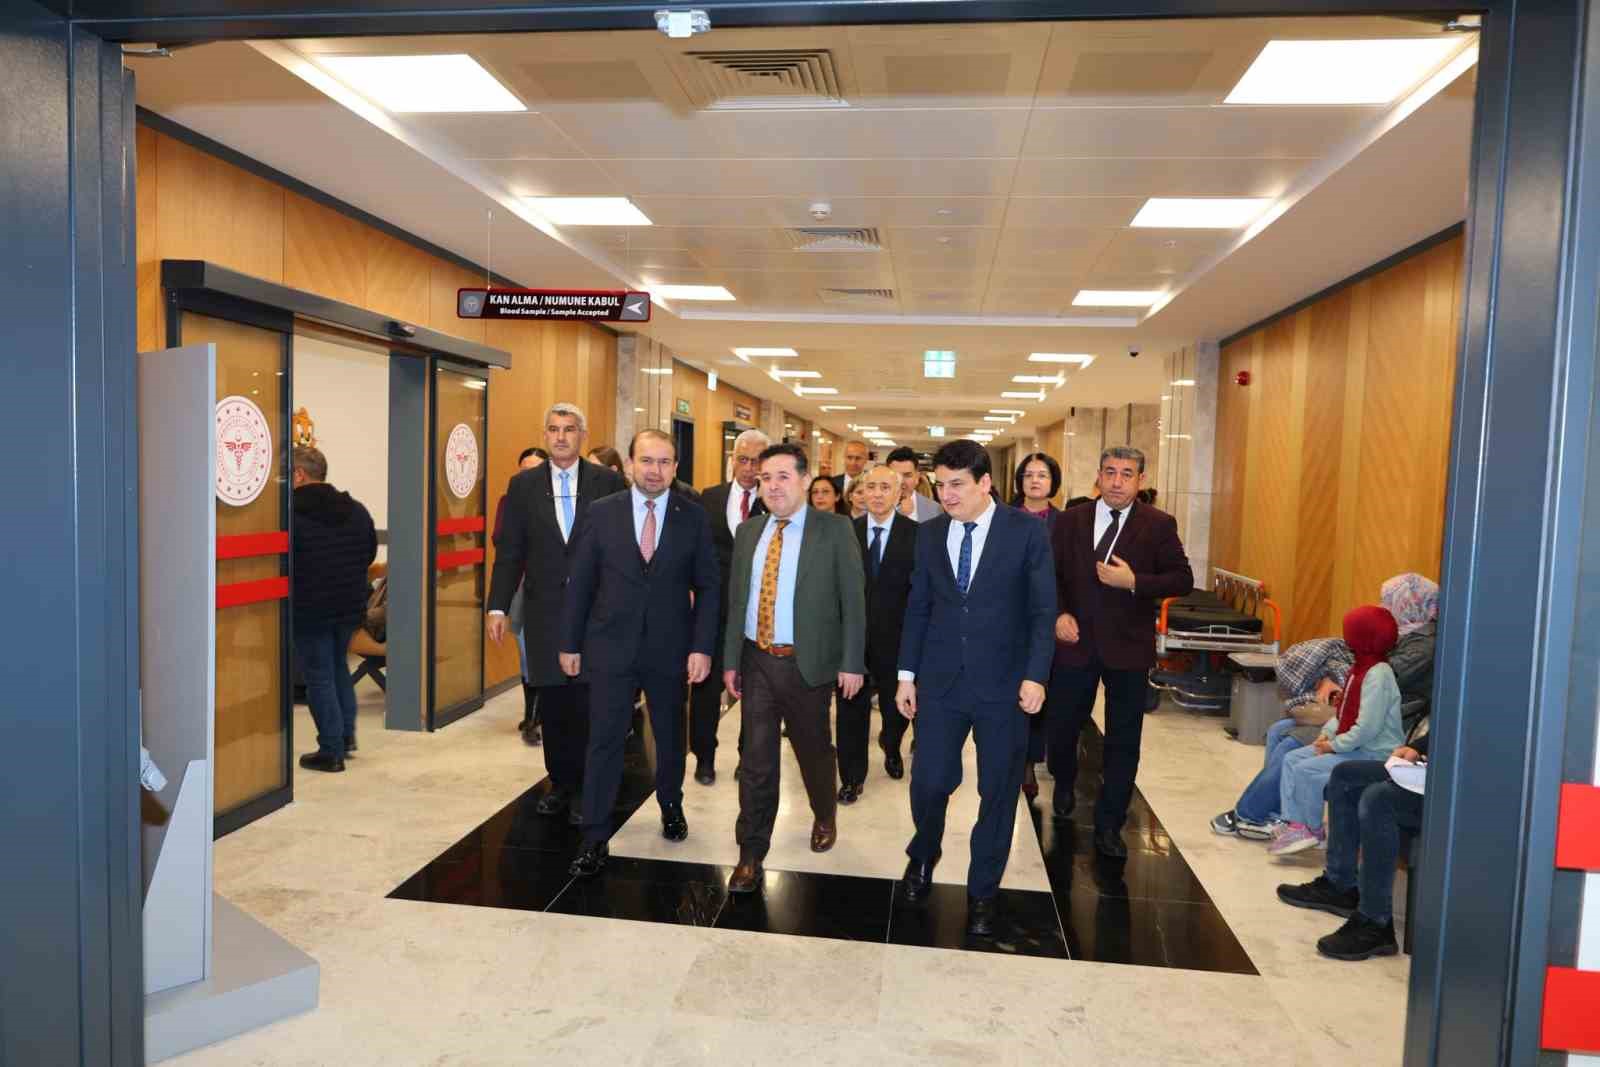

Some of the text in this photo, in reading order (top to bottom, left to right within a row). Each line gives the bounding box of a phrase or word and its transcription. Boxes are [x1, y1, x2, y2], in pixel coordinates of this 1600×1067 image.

[489, 295, 620, 306] KAN ALMA / NUMUNE KABUL
[499, 307, 520, 315] Blood
[521, 308, 546, 316] Sample
[551, 308, 577, 316] Sample
[578, 309, 609, 317] Accepted
